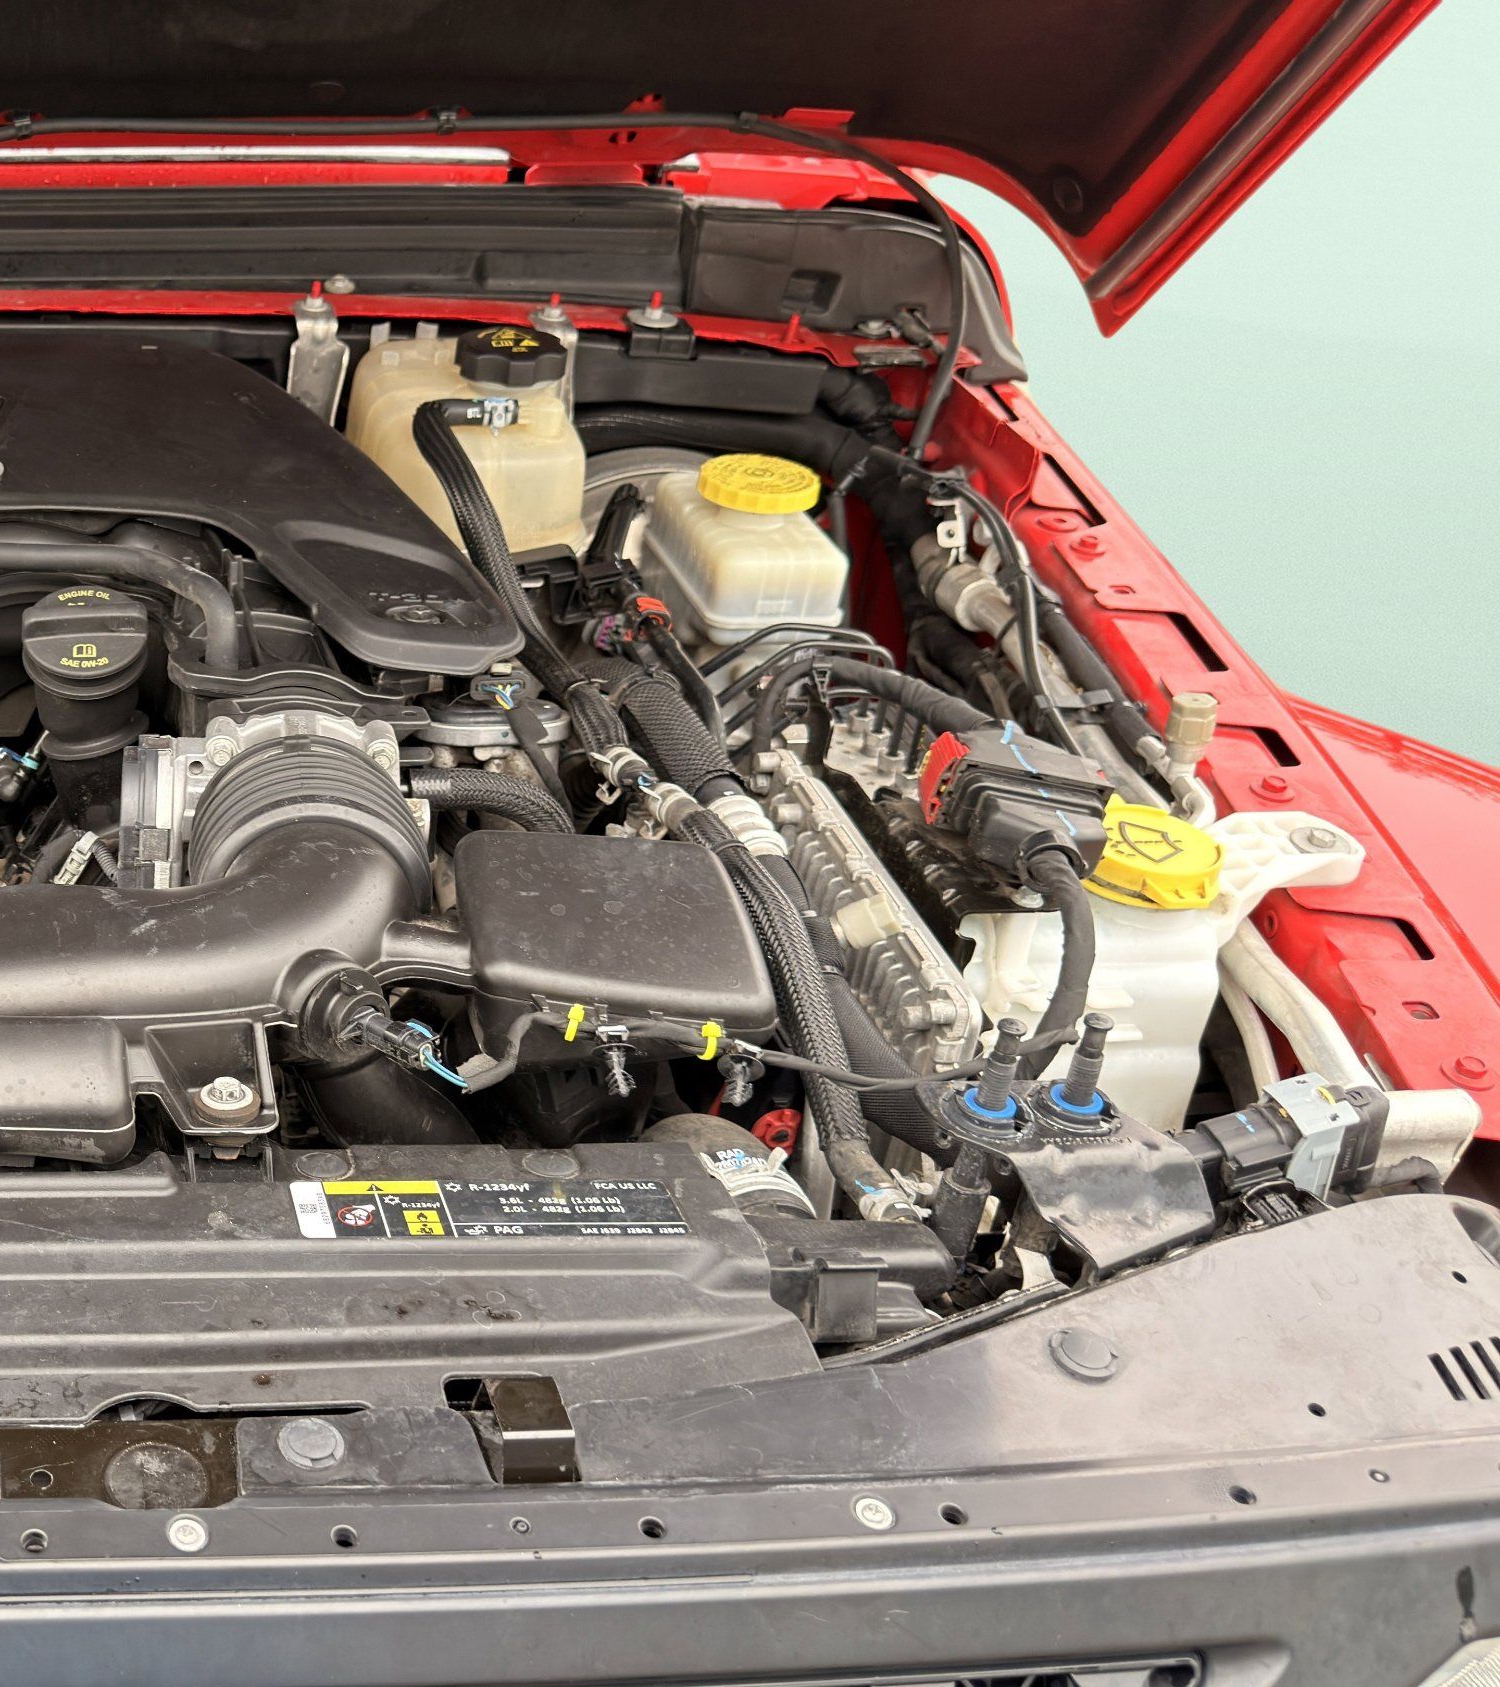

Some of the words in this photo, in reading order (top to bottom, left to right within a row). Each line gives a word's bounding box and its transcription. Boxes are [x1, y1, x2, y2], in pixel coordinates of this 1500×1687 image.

[57, 590, 95, 601] ENGINE
[95, 591, 110, 600] OIL
[60, 657, 80, 668] SAE
[80, 657, 109, 668] 0W-20
[468, 1183, 530, 1192] R-1234yf
[594, 1182, 618, 1190] FCA
[618, 1182, 637, 1190] US
[636, 1182, 657, 1190] LLC
[494, 1226, 524, 1234] PAG
